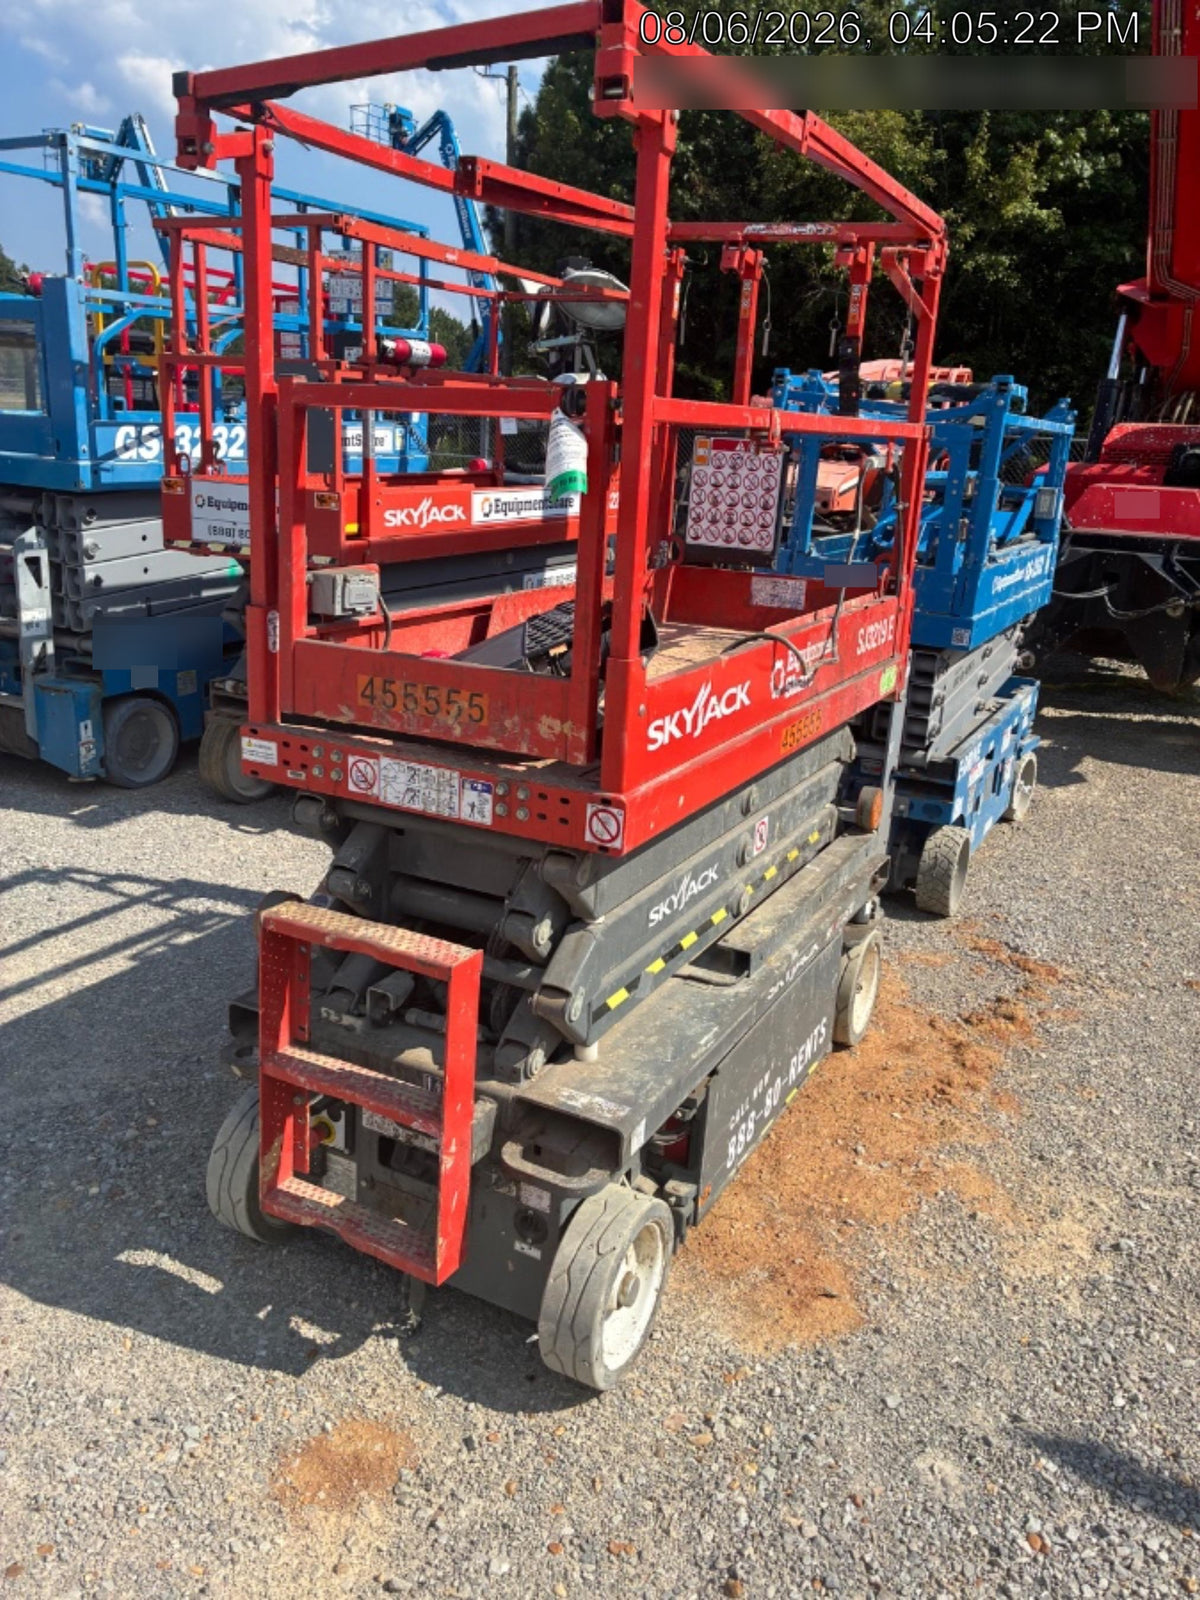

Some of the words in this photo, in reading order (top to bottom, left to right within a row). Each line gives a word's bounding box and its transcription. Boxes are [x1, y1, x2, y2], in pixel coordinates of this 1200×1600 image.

[384, 497, 467, 529] SKYJACK
[361, 677, 485, 723] 455555
[647, 679, 752, 751] SKYJACK
[648, 862, 720, 928] SKYJACK
[726, 1016, 828, 1169] 888-80-RENTS
